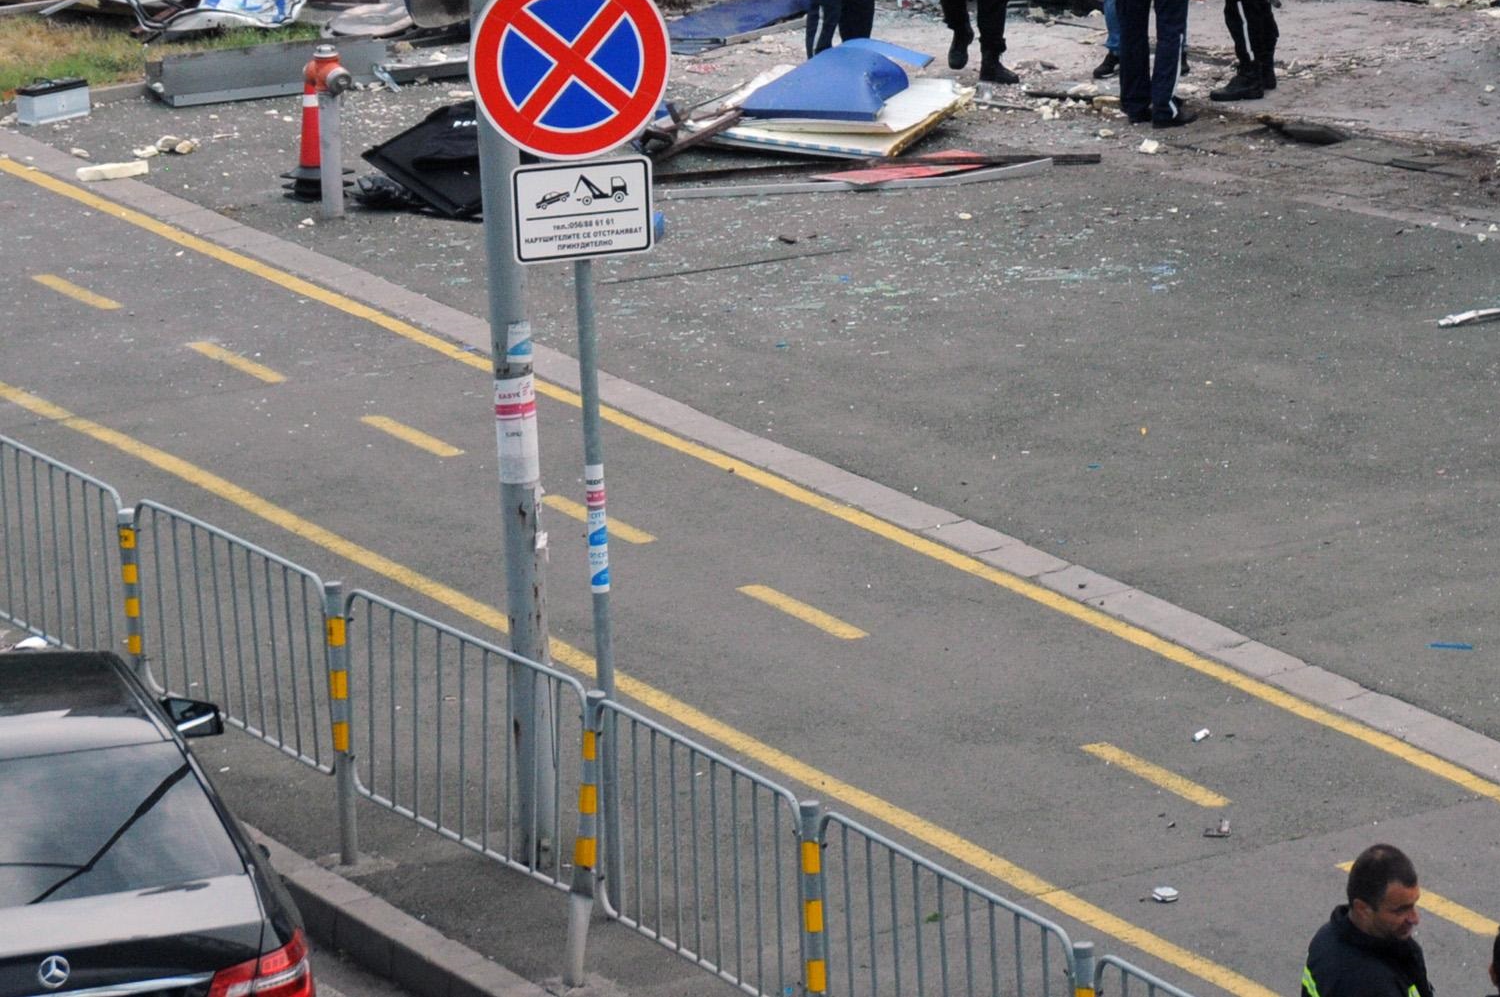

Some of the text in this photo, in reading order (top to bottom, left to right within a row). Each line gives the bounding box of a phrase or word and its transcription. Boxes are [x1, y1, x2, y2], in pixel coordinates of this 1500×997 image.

[525, 226, 643, 244] НАРУШИТЕЛИТЕ СЕ ОТСТРАНЯВАТ
[556, 239, 614, 251] ПРИНУДИТЕЛНО
